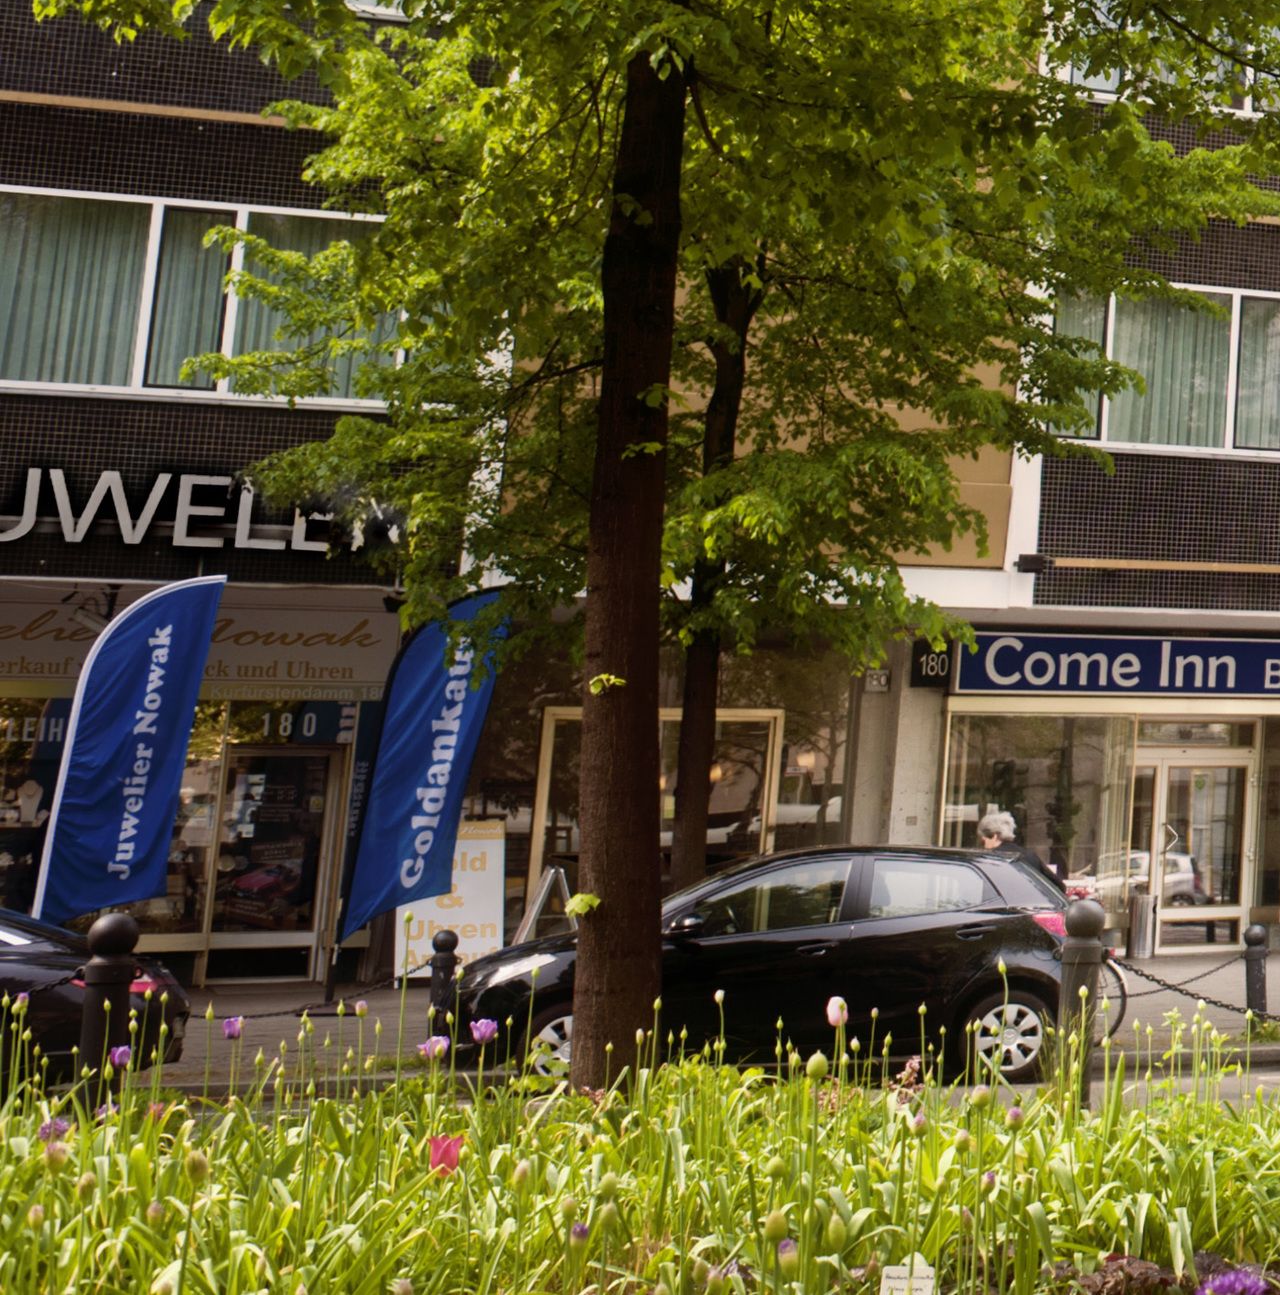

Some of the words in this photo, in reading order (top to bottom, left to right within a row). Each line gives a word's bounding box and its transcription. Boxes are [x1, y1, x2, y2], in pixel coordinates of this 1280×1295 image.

[237, 660, 278, 679] und
[287, 661, 354, 680] Uhren
[920, 653, 949, 676] 180
[985, 637, 1141, 687] Come
[1159, 641, 1236, 689] Inn
[262, 712, 317, 737] 180
[107, 742, 153, 881] Juwelier
[133, 624, 173, 735] Nowak
